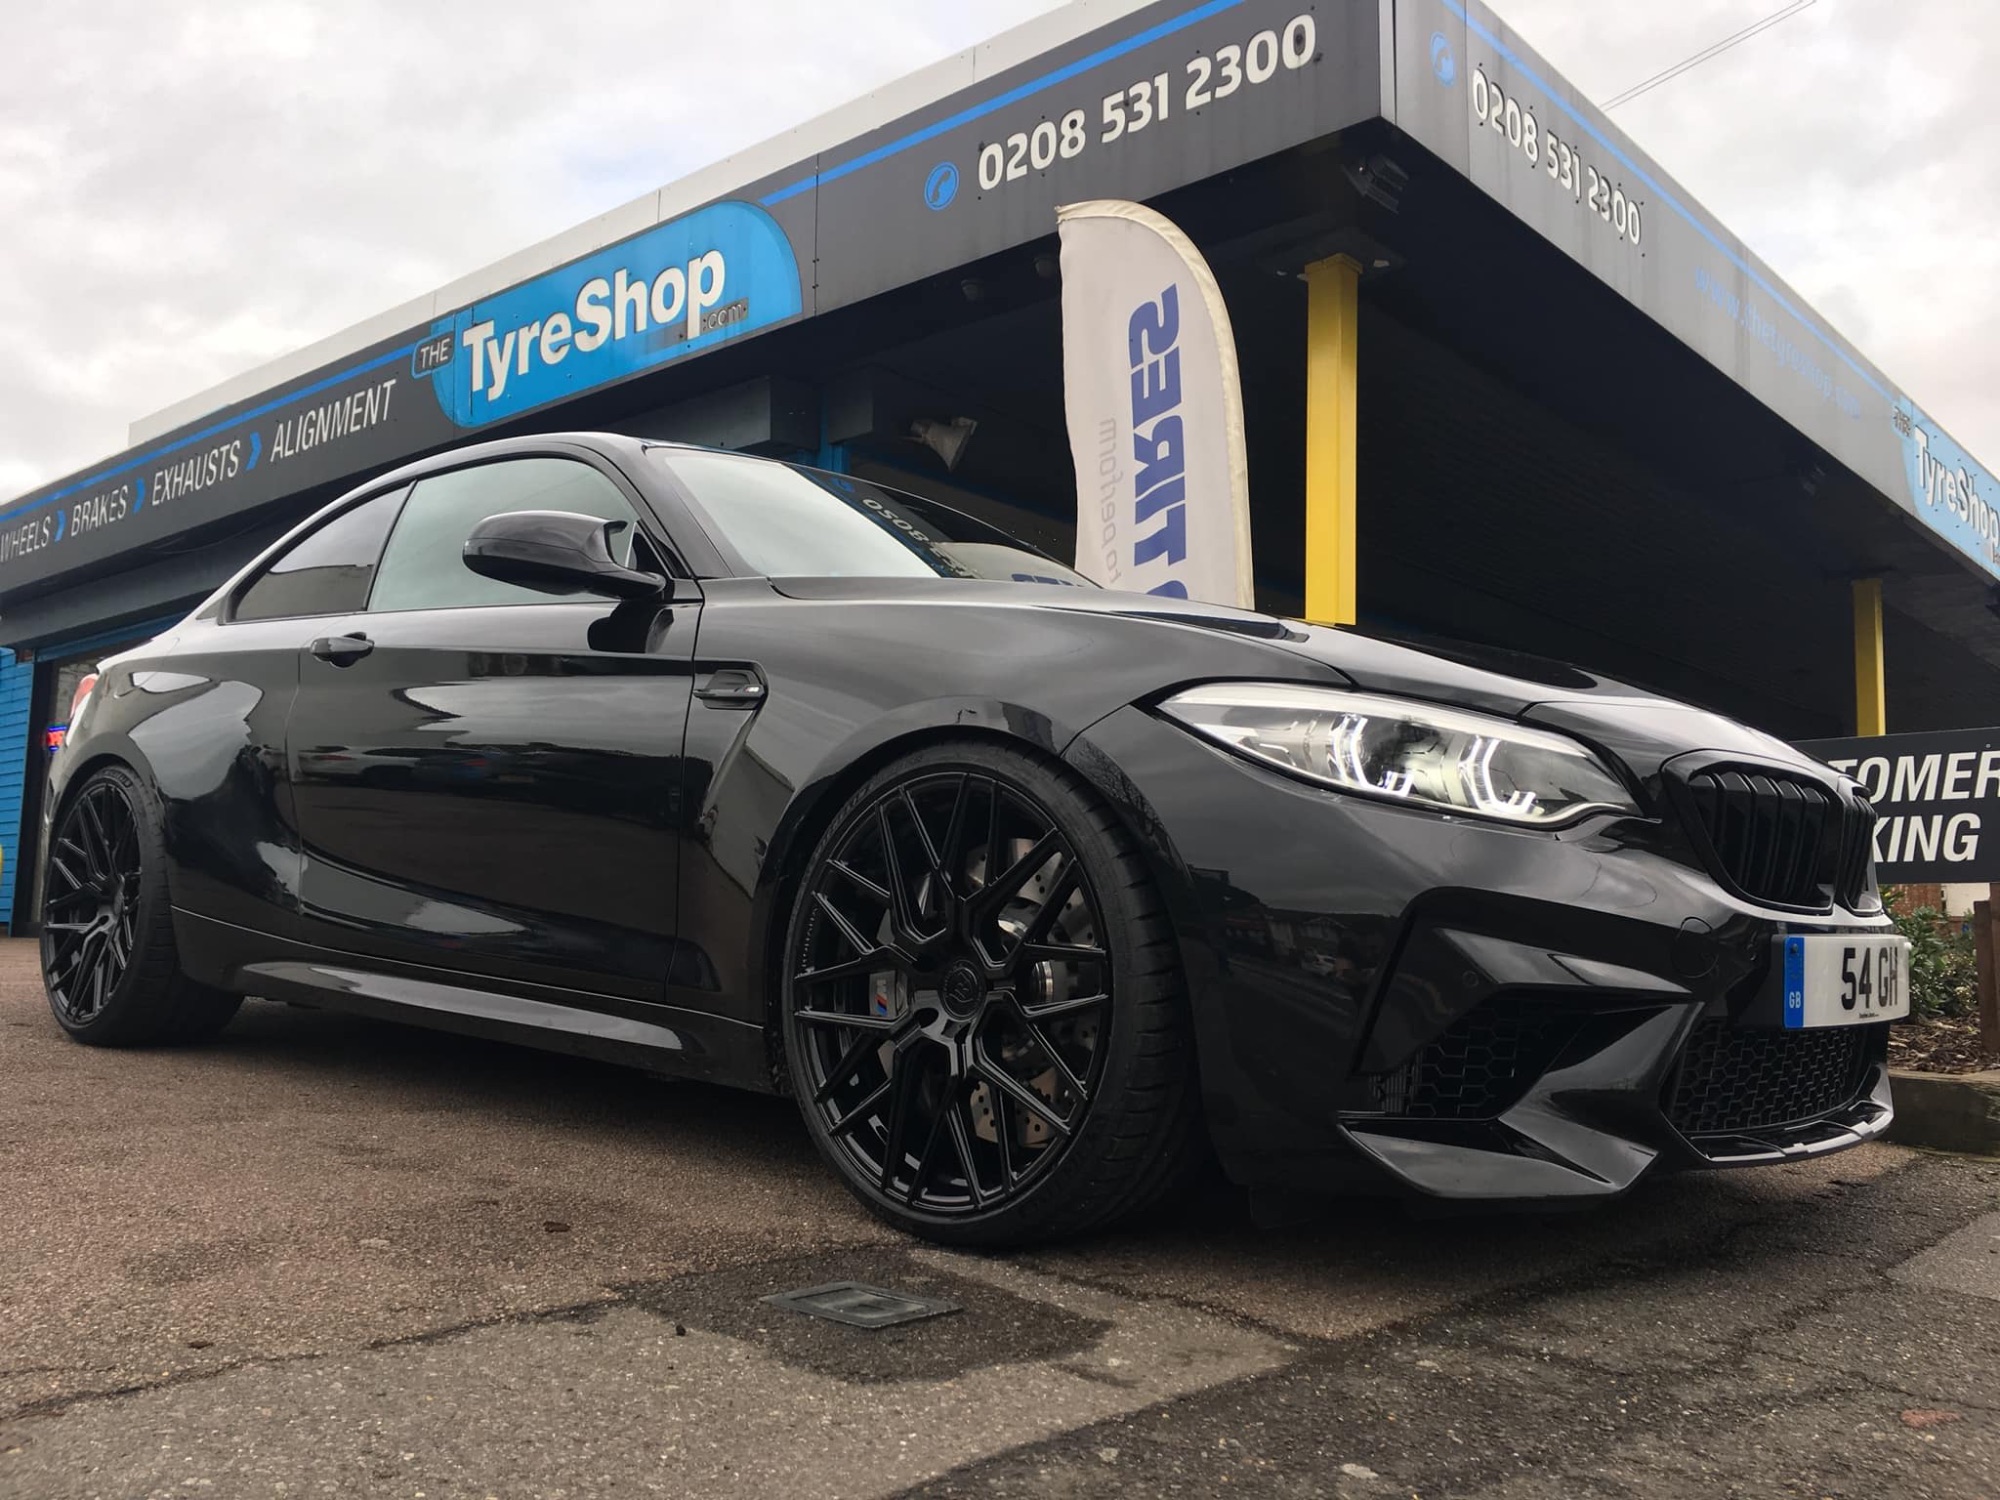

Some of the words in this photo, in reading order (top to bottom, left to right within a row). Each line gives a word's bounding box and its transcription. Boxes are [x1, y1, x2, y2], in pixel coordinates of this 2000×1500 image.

[978, 109, 1086, 190] 0208
[1101, 72, 1170, 143] 531
[1186, 14, 1317, 110] 2300
[1472, 68, 1539, 162] 0208
[1547, 130, 1581, 200] 531
[1588, 165, 1642, 245] 2300
[420, 337, 451, 370] THE
[463, 250, 726, 402] TyreShop
[0, 515, 51, 562] WHEELS
[71, 484, 129, 537] BRAKES
[152, 440, 241, 506] EXHAUSTS
[270, 379, 397, 462] ALIGNMENT
[1914, 424, 2000, 564] TyreShop
[1789, 991, 1801, 1008] GB
[1841, 947, 1872, 1010] 54
